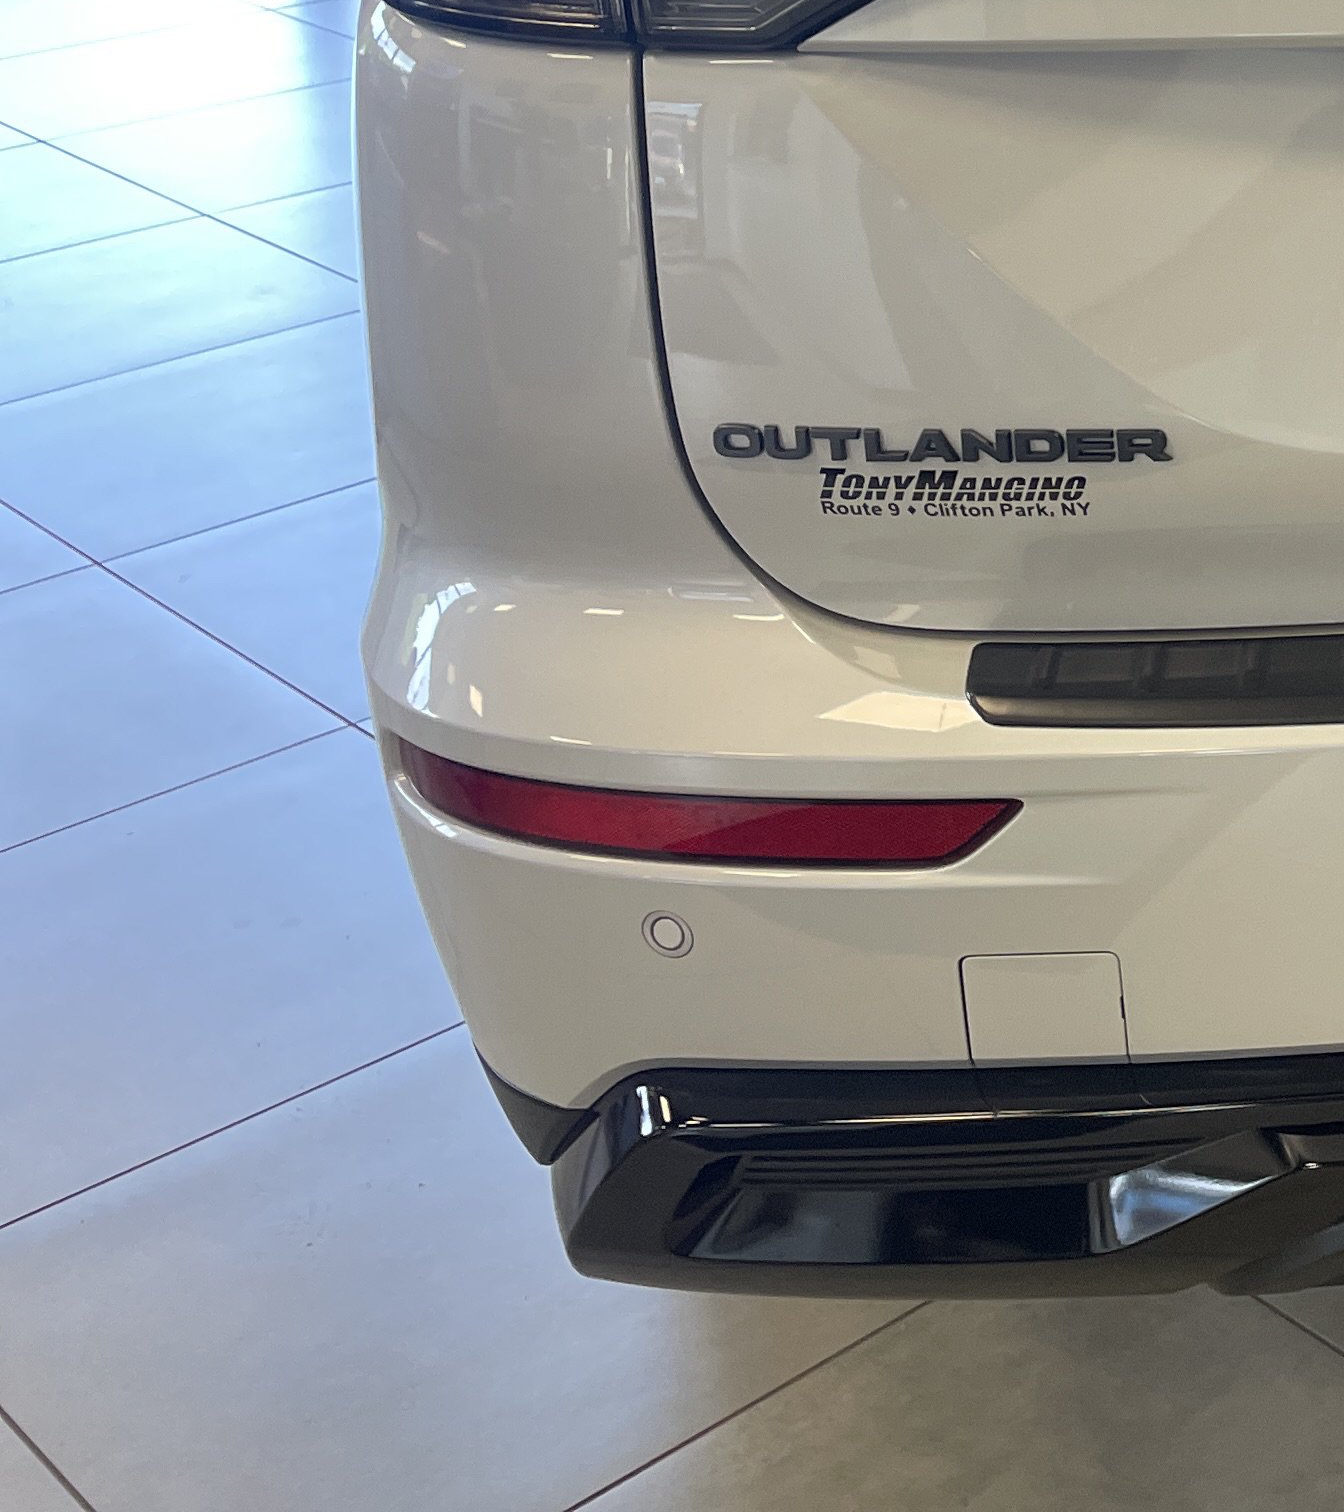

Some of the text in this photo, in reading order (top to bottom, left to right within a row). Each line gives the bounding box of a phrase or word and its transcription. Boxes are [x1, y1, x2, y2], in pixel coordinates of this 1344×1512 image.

[712, 423, 1173, 464] OUTLANDER
[820, 500, 1090, 518] Route 9 Clifton Park, NY
